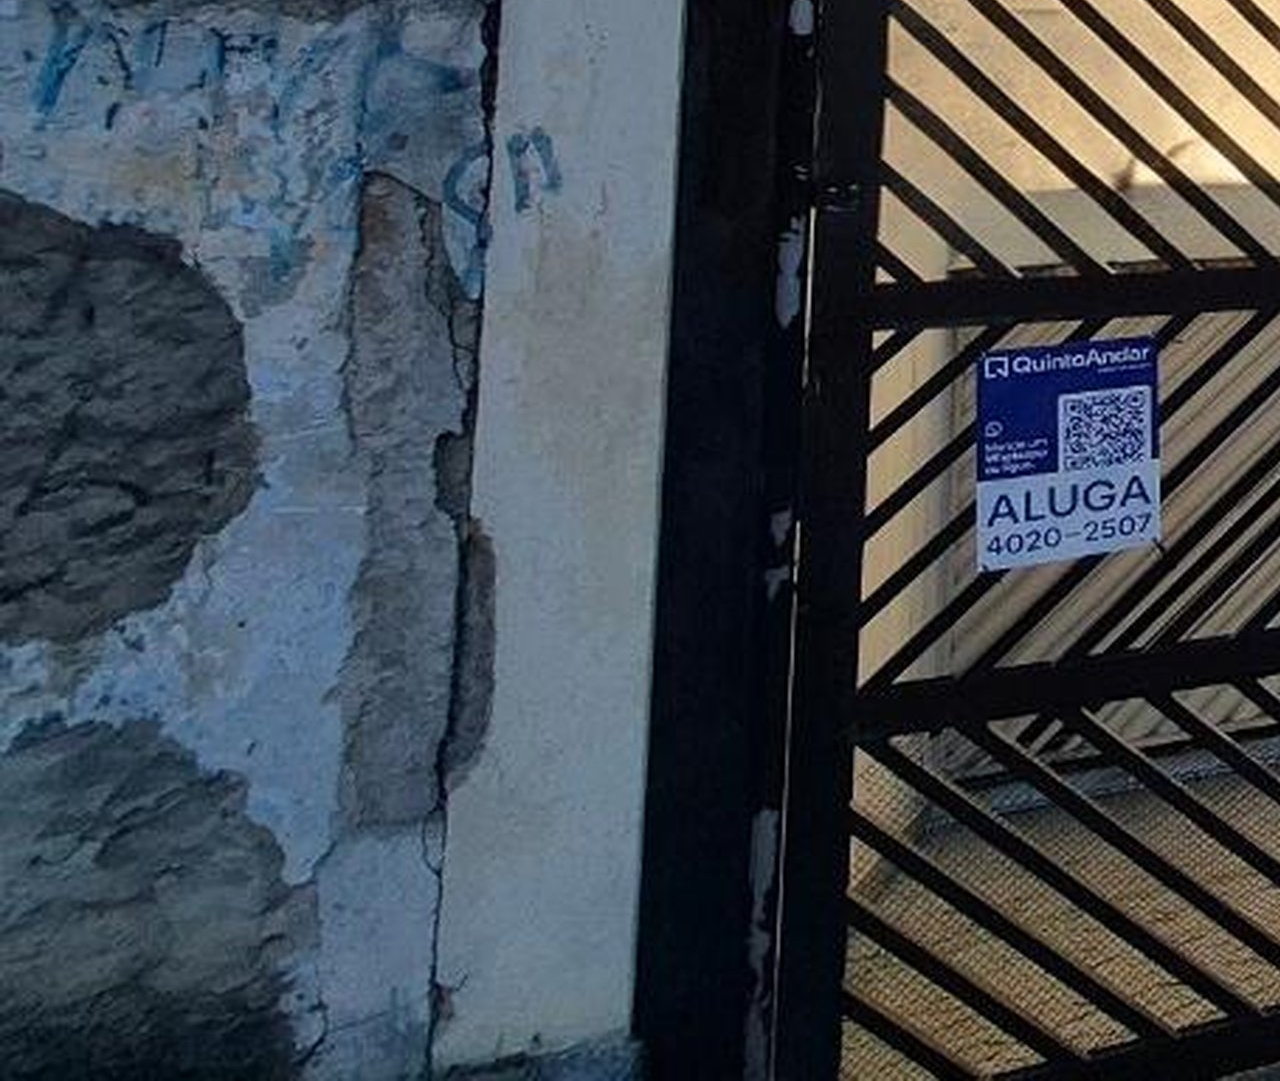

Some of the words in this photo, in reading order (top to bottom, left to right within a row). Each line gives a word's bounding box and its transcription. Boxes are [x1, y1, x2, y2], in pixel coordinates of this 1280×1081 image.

[1012, 347, 1149, 373] QuintoAndar
[987, 475, 1152, 527] ALUGA
[987, 514, 1152, 555] 4020-2507
